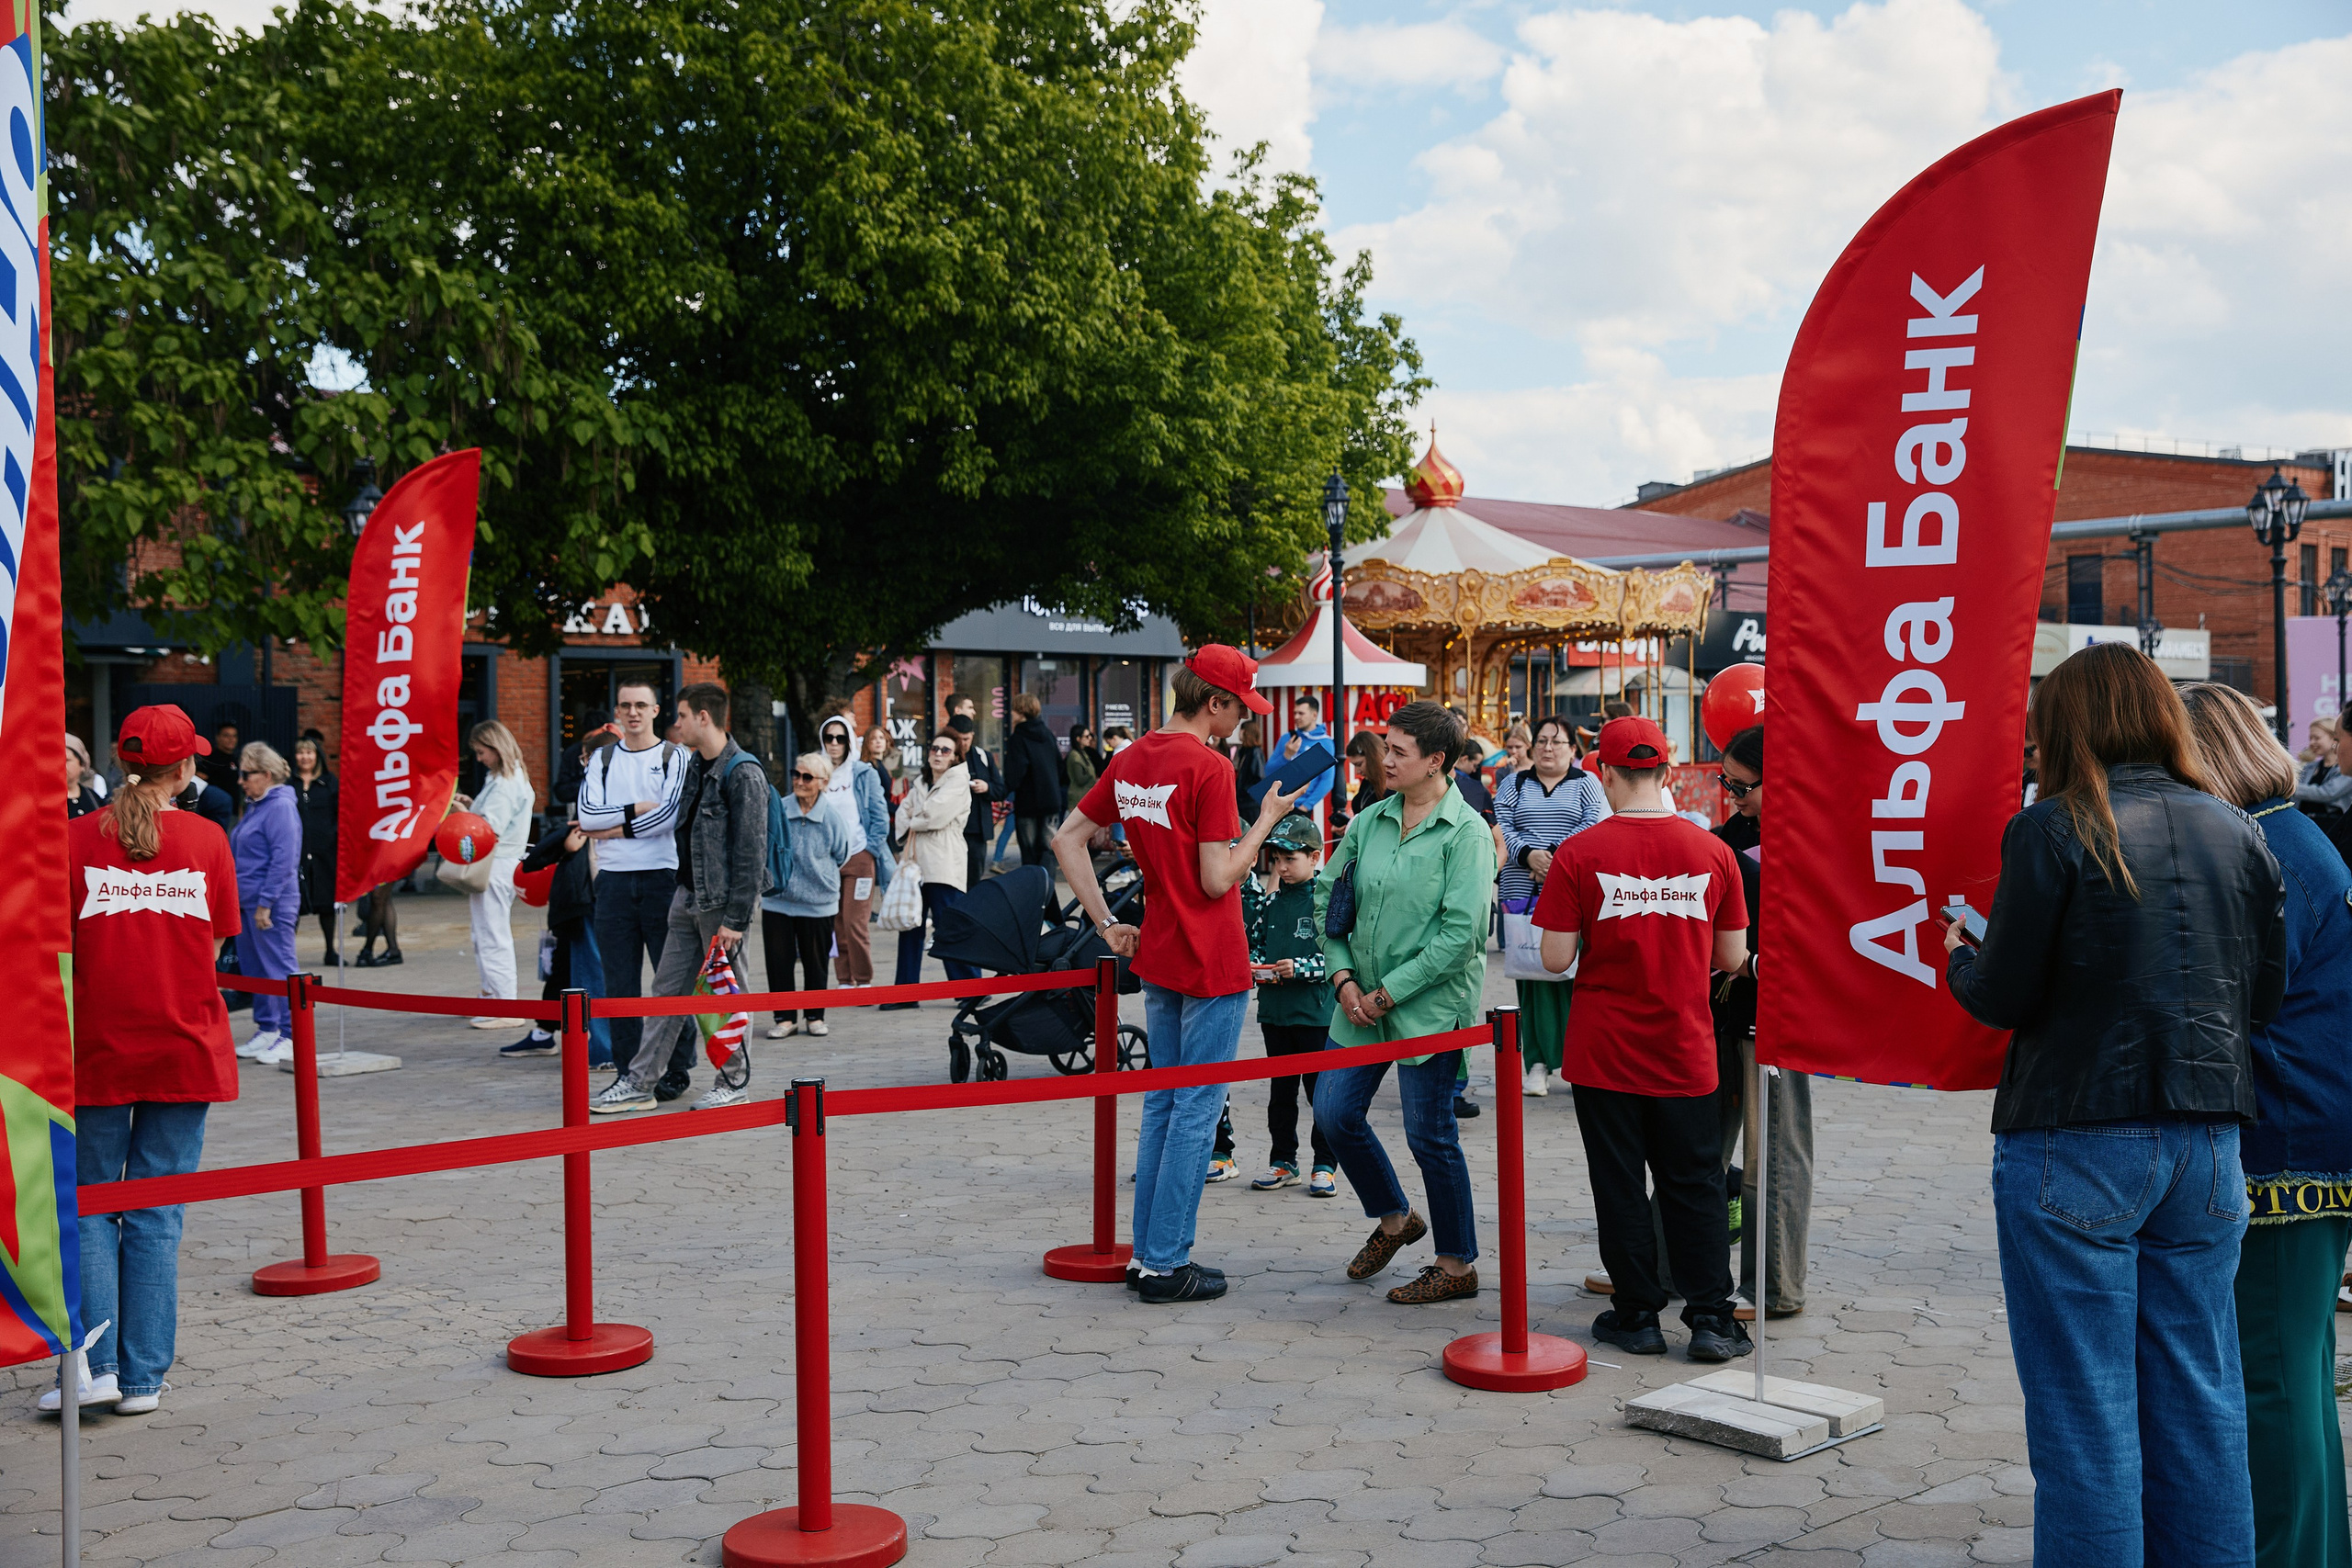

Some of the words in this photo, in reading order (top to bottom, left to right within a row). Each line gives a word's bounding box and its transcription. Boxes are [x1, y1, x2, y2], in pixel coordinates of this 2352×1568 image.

[1865, 264, 1984, 568] Банк
[376, 520, 425, 663] Банк
[367, 674, 425, 842] Альфа
[1849, 596, 1965, 988] Альфа
[97, 882, 152, 901] Альфа
[156, 884, 197, 898] Банк
[1612, 887, 1657, 906] Альфа
[1661, 887, 1697, 901] Банк
